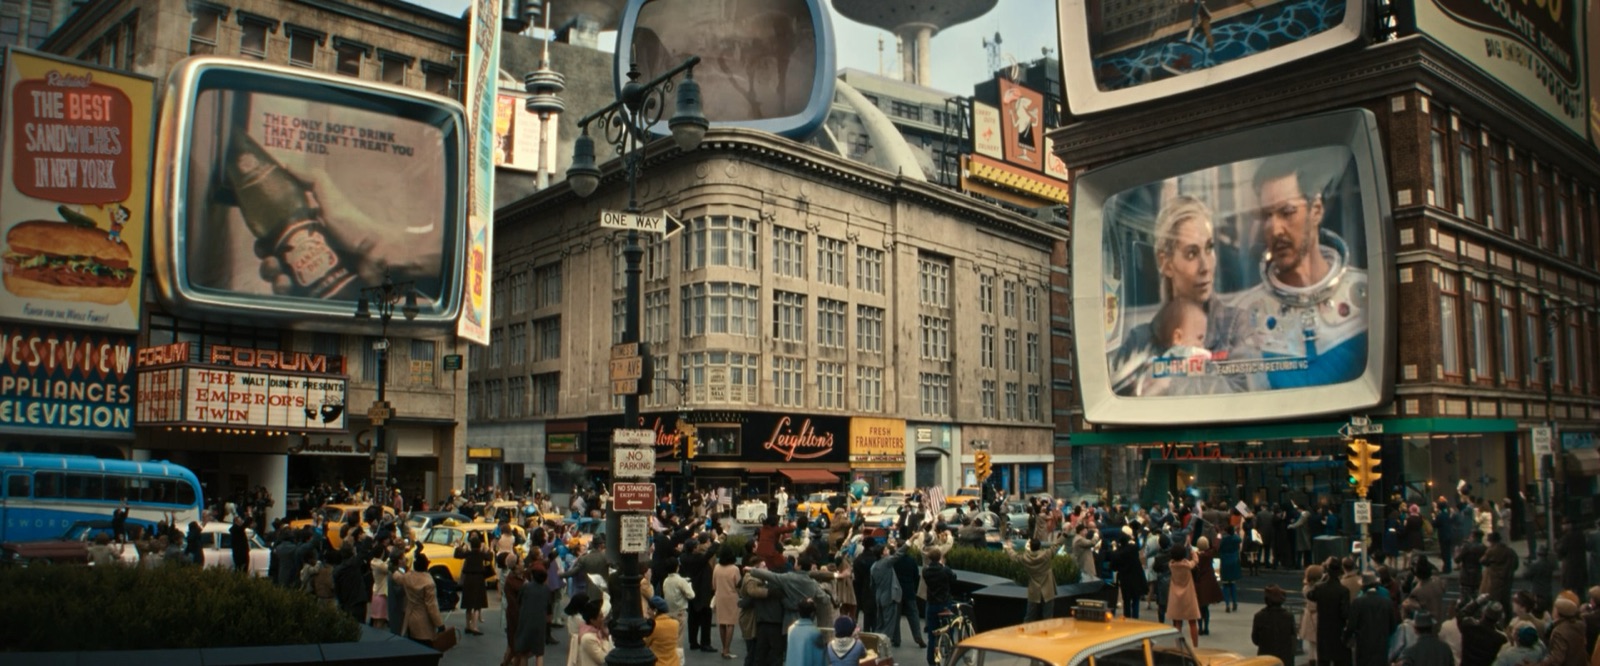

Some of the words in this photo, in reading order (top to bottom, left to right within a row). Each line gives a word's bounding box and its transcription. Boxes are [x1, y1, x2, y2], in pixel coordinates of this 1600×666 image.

[1485, 37, 1502, 58] BIG
[30, 90, 64, 119] THE
[68, 92, 112, 121] BEST
[264, 112, 287, 126] THE
[292, 117, 322, 130] ONLY
[326, 121, 354, 135] SOFT
[359, 126, 395, 142] DRINK
[24, 122, 122, 155] SANDWICHES
[263, 124, 294, 138] THAT
[299, 131, 349, 147] DOESN'T
[352, 138, 390, 153] TREAT
[391, 144, 415, 157] YOU
[264, 135, 291, 149] LIKE
[295, 141, 303, 151] A
[306, 143, 330, 155] KID.
[34, 157, 49, 188] IN
[50, 157, 78, 188] NEW
[80, 158, 116, 189] YORK
[604, 212, 627, 226] ONE
[635, 216, 660, 229] WAY
[136, 342, 187, 367] FORUM
[211, 345, 327, 373] FORUM
[627, 359, 641, 376] AVE
[198, 371, 235, 386] THE
[241, 376, 265, 386] WALT
[270, 378, 299, 389] DISNEY
[302, 380, 344, 392] PRESENTS
[1, 376, 131, 404] PPLIANCES
[195, 388, 305, 407] EMPEROR'S
[0, 401, 130, 429] ELEVISION
[195, 406, 249, 421] TWIN
[764, 416, 834, 461] Leighton's
[869, 427, 891, 436] FRESH
[855, 436, 904, 449] FRANKFURTERS
[1153, 441, 1231, 460] Vista
[619, 462, 651, 470] PARKING
[628, 451, 643, 461] NO
